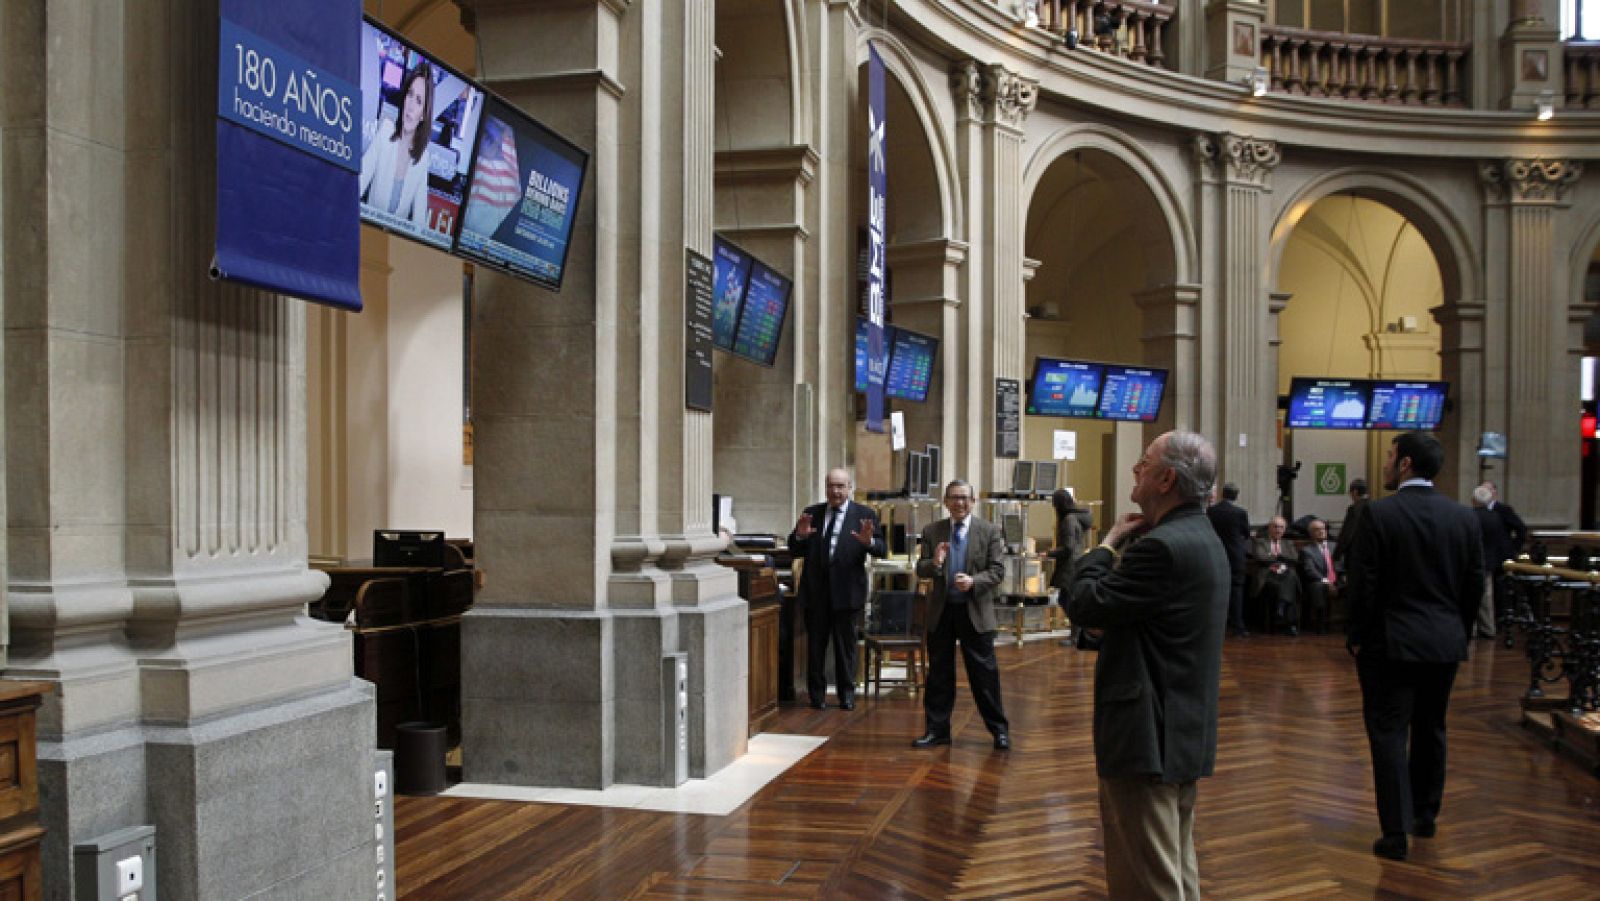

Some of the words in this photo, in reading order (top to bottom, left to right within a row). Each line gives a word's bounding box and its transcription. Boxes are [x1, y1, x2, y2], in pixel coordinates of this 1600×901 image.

[235, 43, 276, 98] 180
[283, 69, 352, 133] AÑOS
[235, 85, 297, 137] haciendo
[300, 126, 352, 161] mercado
